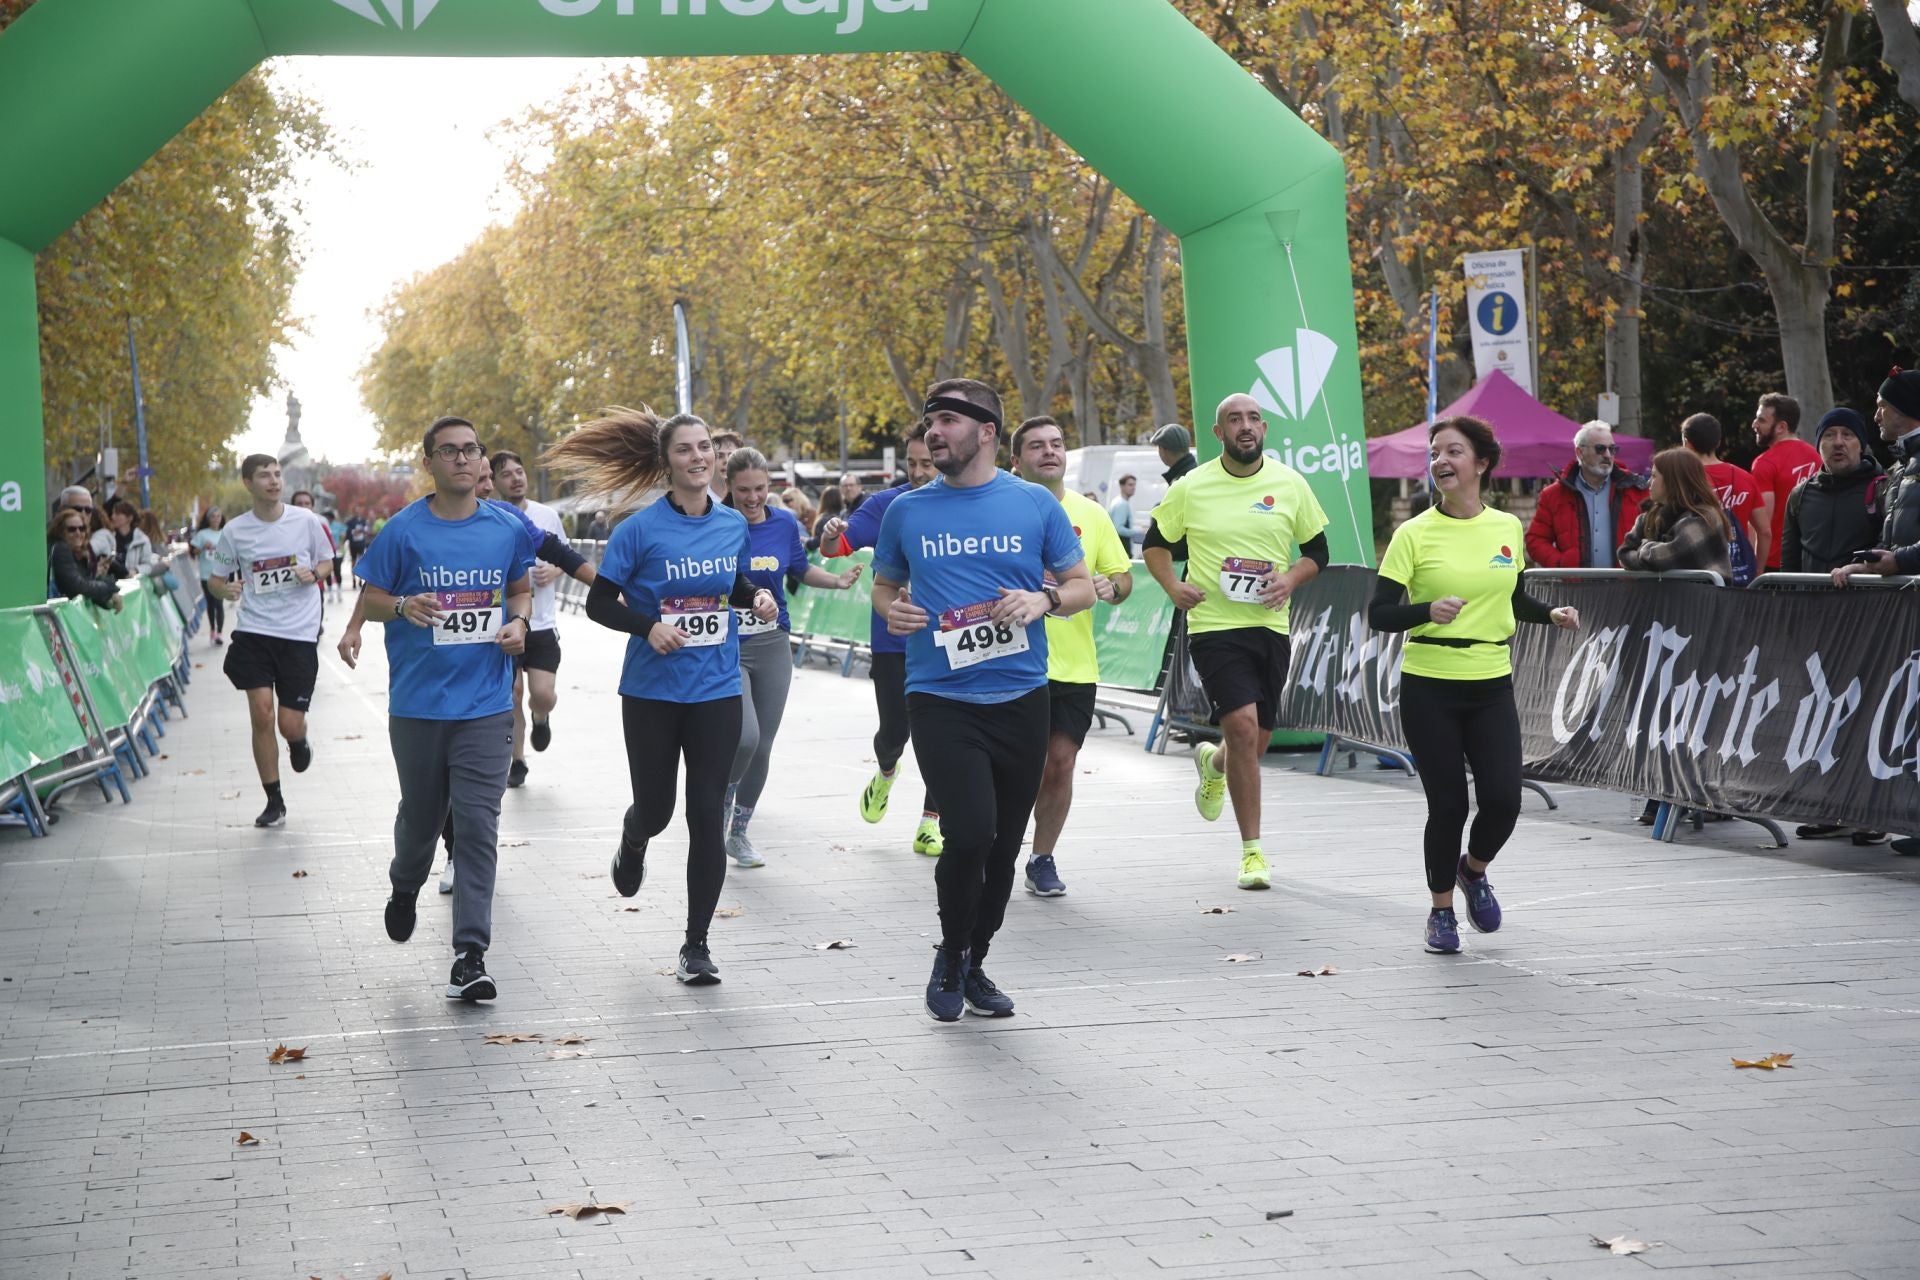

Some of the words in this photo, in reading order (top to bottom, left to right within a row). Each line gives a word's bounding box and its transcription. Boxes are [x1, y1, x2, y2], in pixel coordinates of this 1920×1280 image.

[921, 532, 1022, 559] hiberus
[260, 569, 293, 586] 212
[419, 565, 502, 588] hiberus
[665, 555, 739, 581] hiberus
[443, 611, 492, 633] 497
[674, 615, 719, 635] 496
[957, 621, 1013, 653] 498
[1552, 624, 1630, 744] El
[1625, 620, 1781, 768] Norte
[1782, 651, 1861, 776] de
